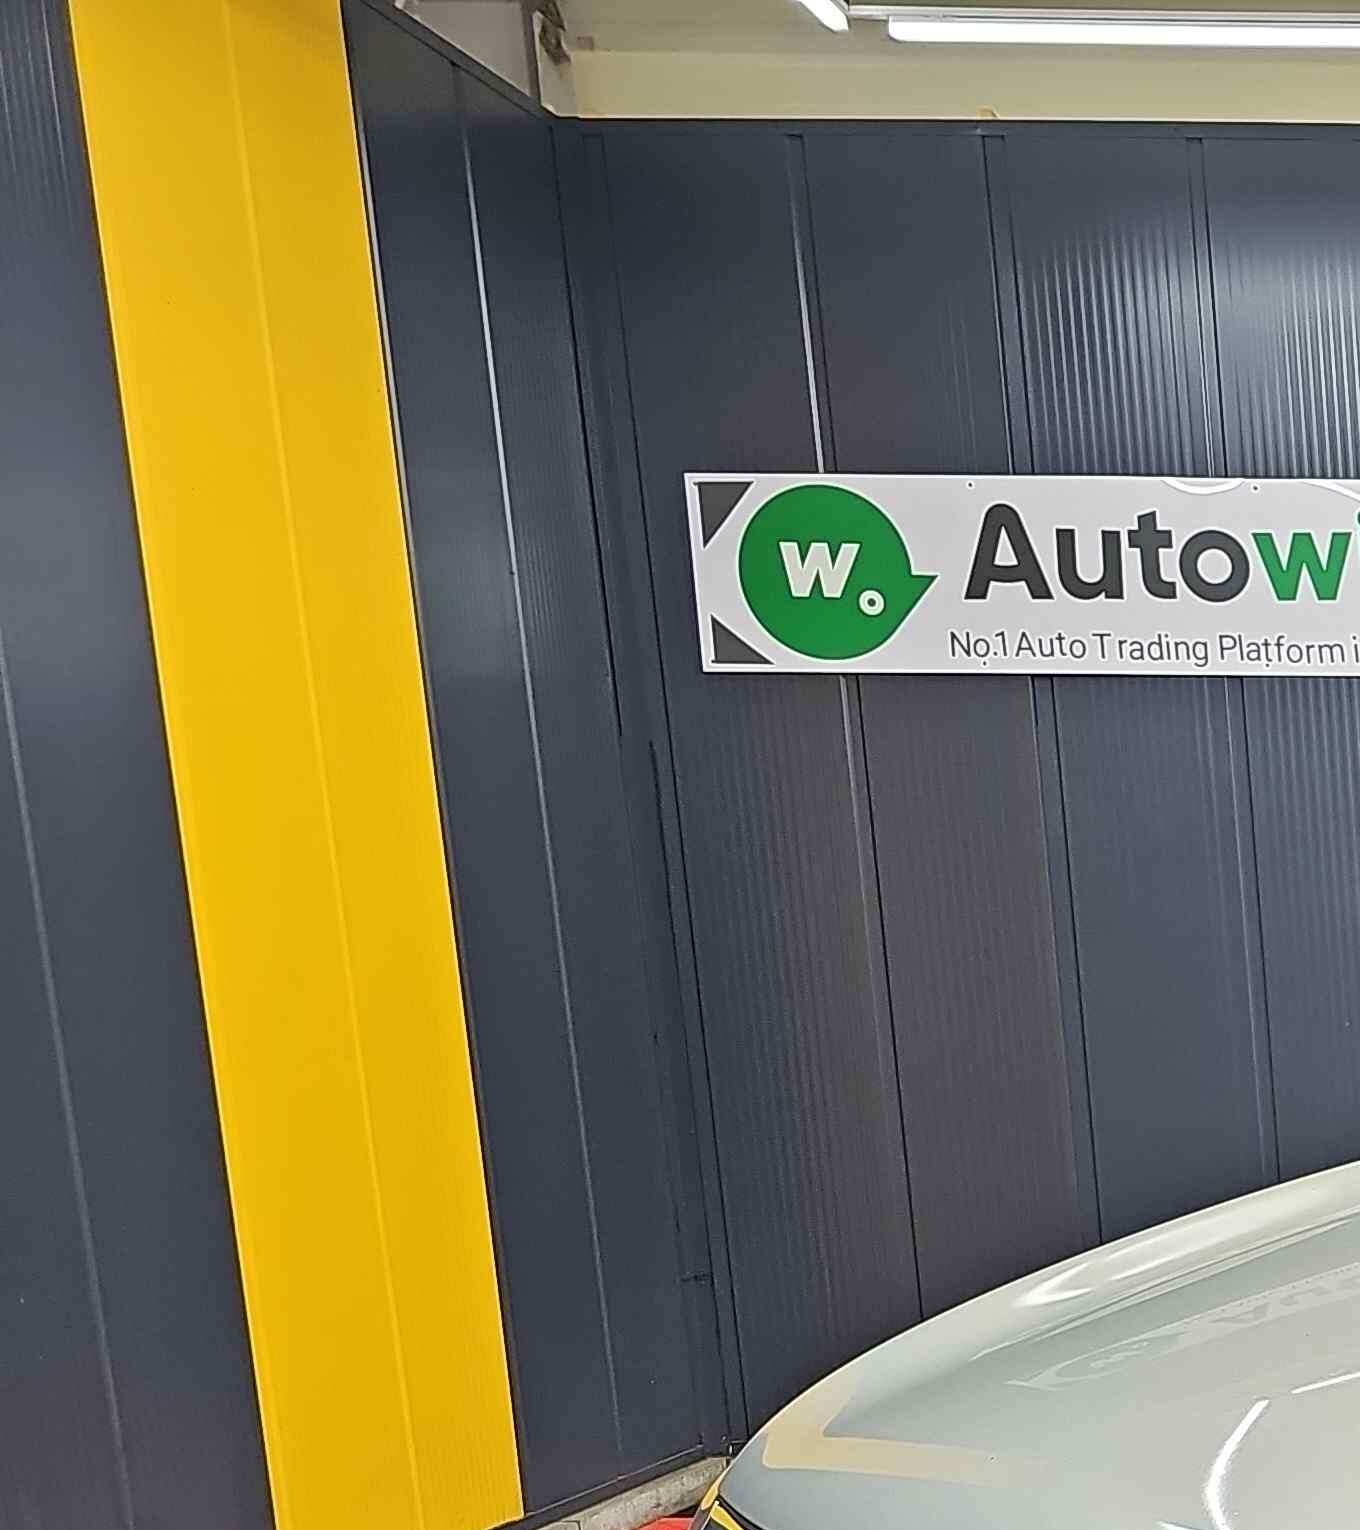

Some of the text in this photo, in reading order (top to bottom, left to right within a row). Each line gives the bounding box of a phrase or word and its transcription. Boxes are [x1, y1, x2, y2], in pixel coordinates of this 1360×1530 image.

[1014, 630, 1087, 659] Auto
[1092, 632, 1209, 667] Trading
[1218, 634, 1345, 664] Platform
